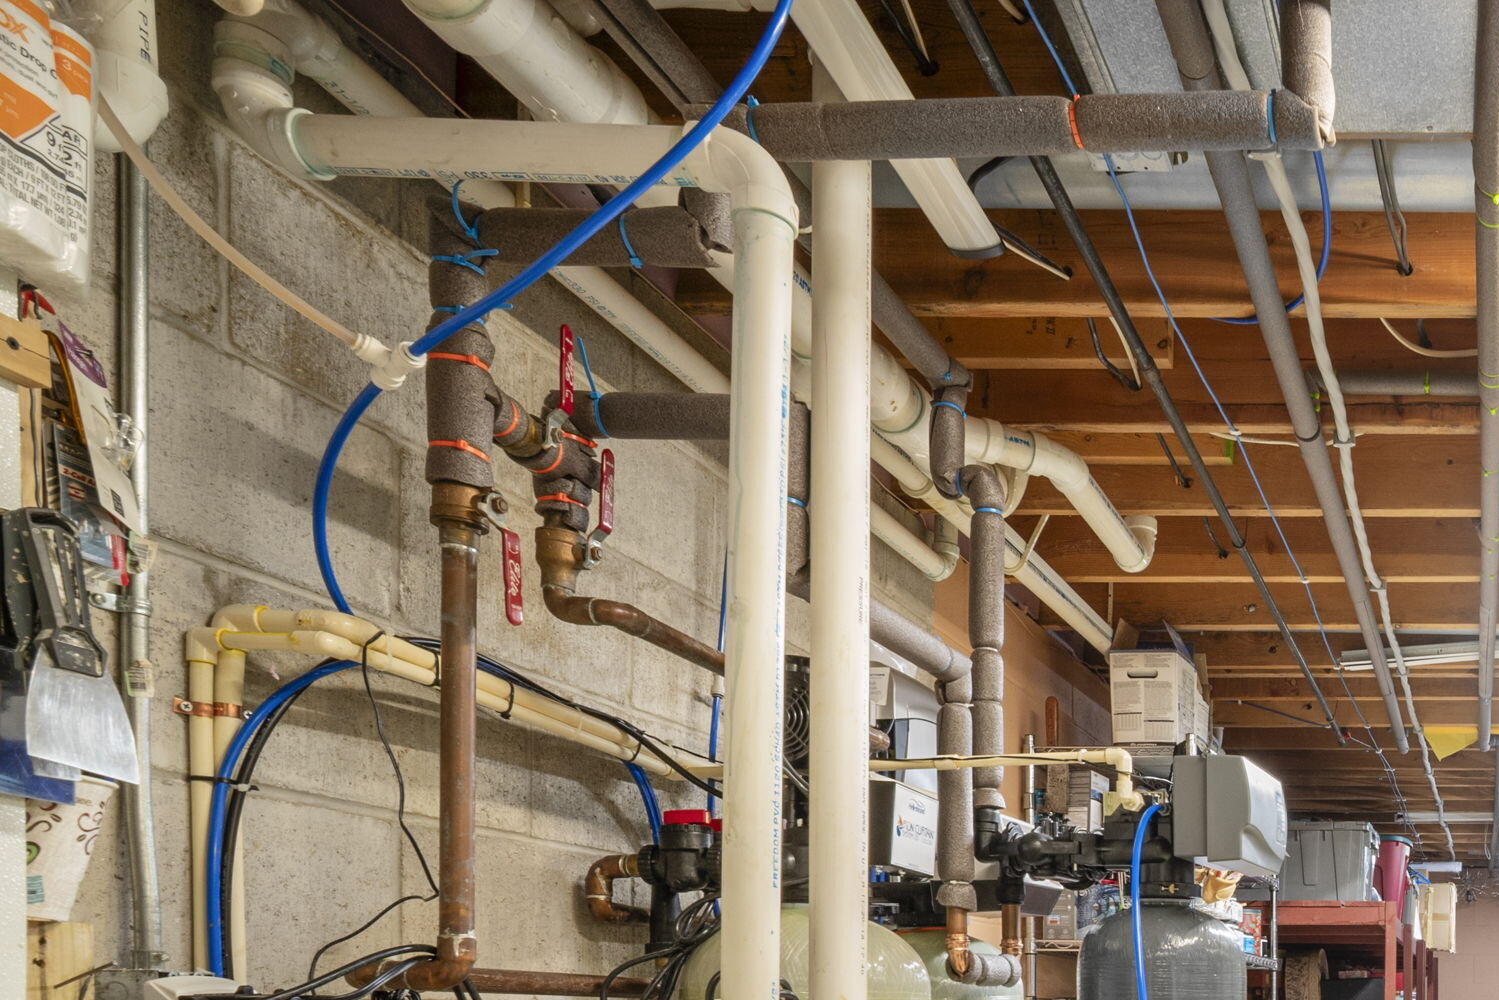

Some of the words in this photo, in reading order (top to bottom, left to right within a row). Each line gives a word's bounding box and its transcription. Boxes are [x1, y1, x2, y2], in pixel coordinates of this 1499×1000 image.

[20, 46, 47, 73] Drop
[46, 131, 56, 147] 9
[508, 559, 521, 597] Elite
[772, 800, 780, 825] PVC
[772, 828, 780, 889] FREEDOM
